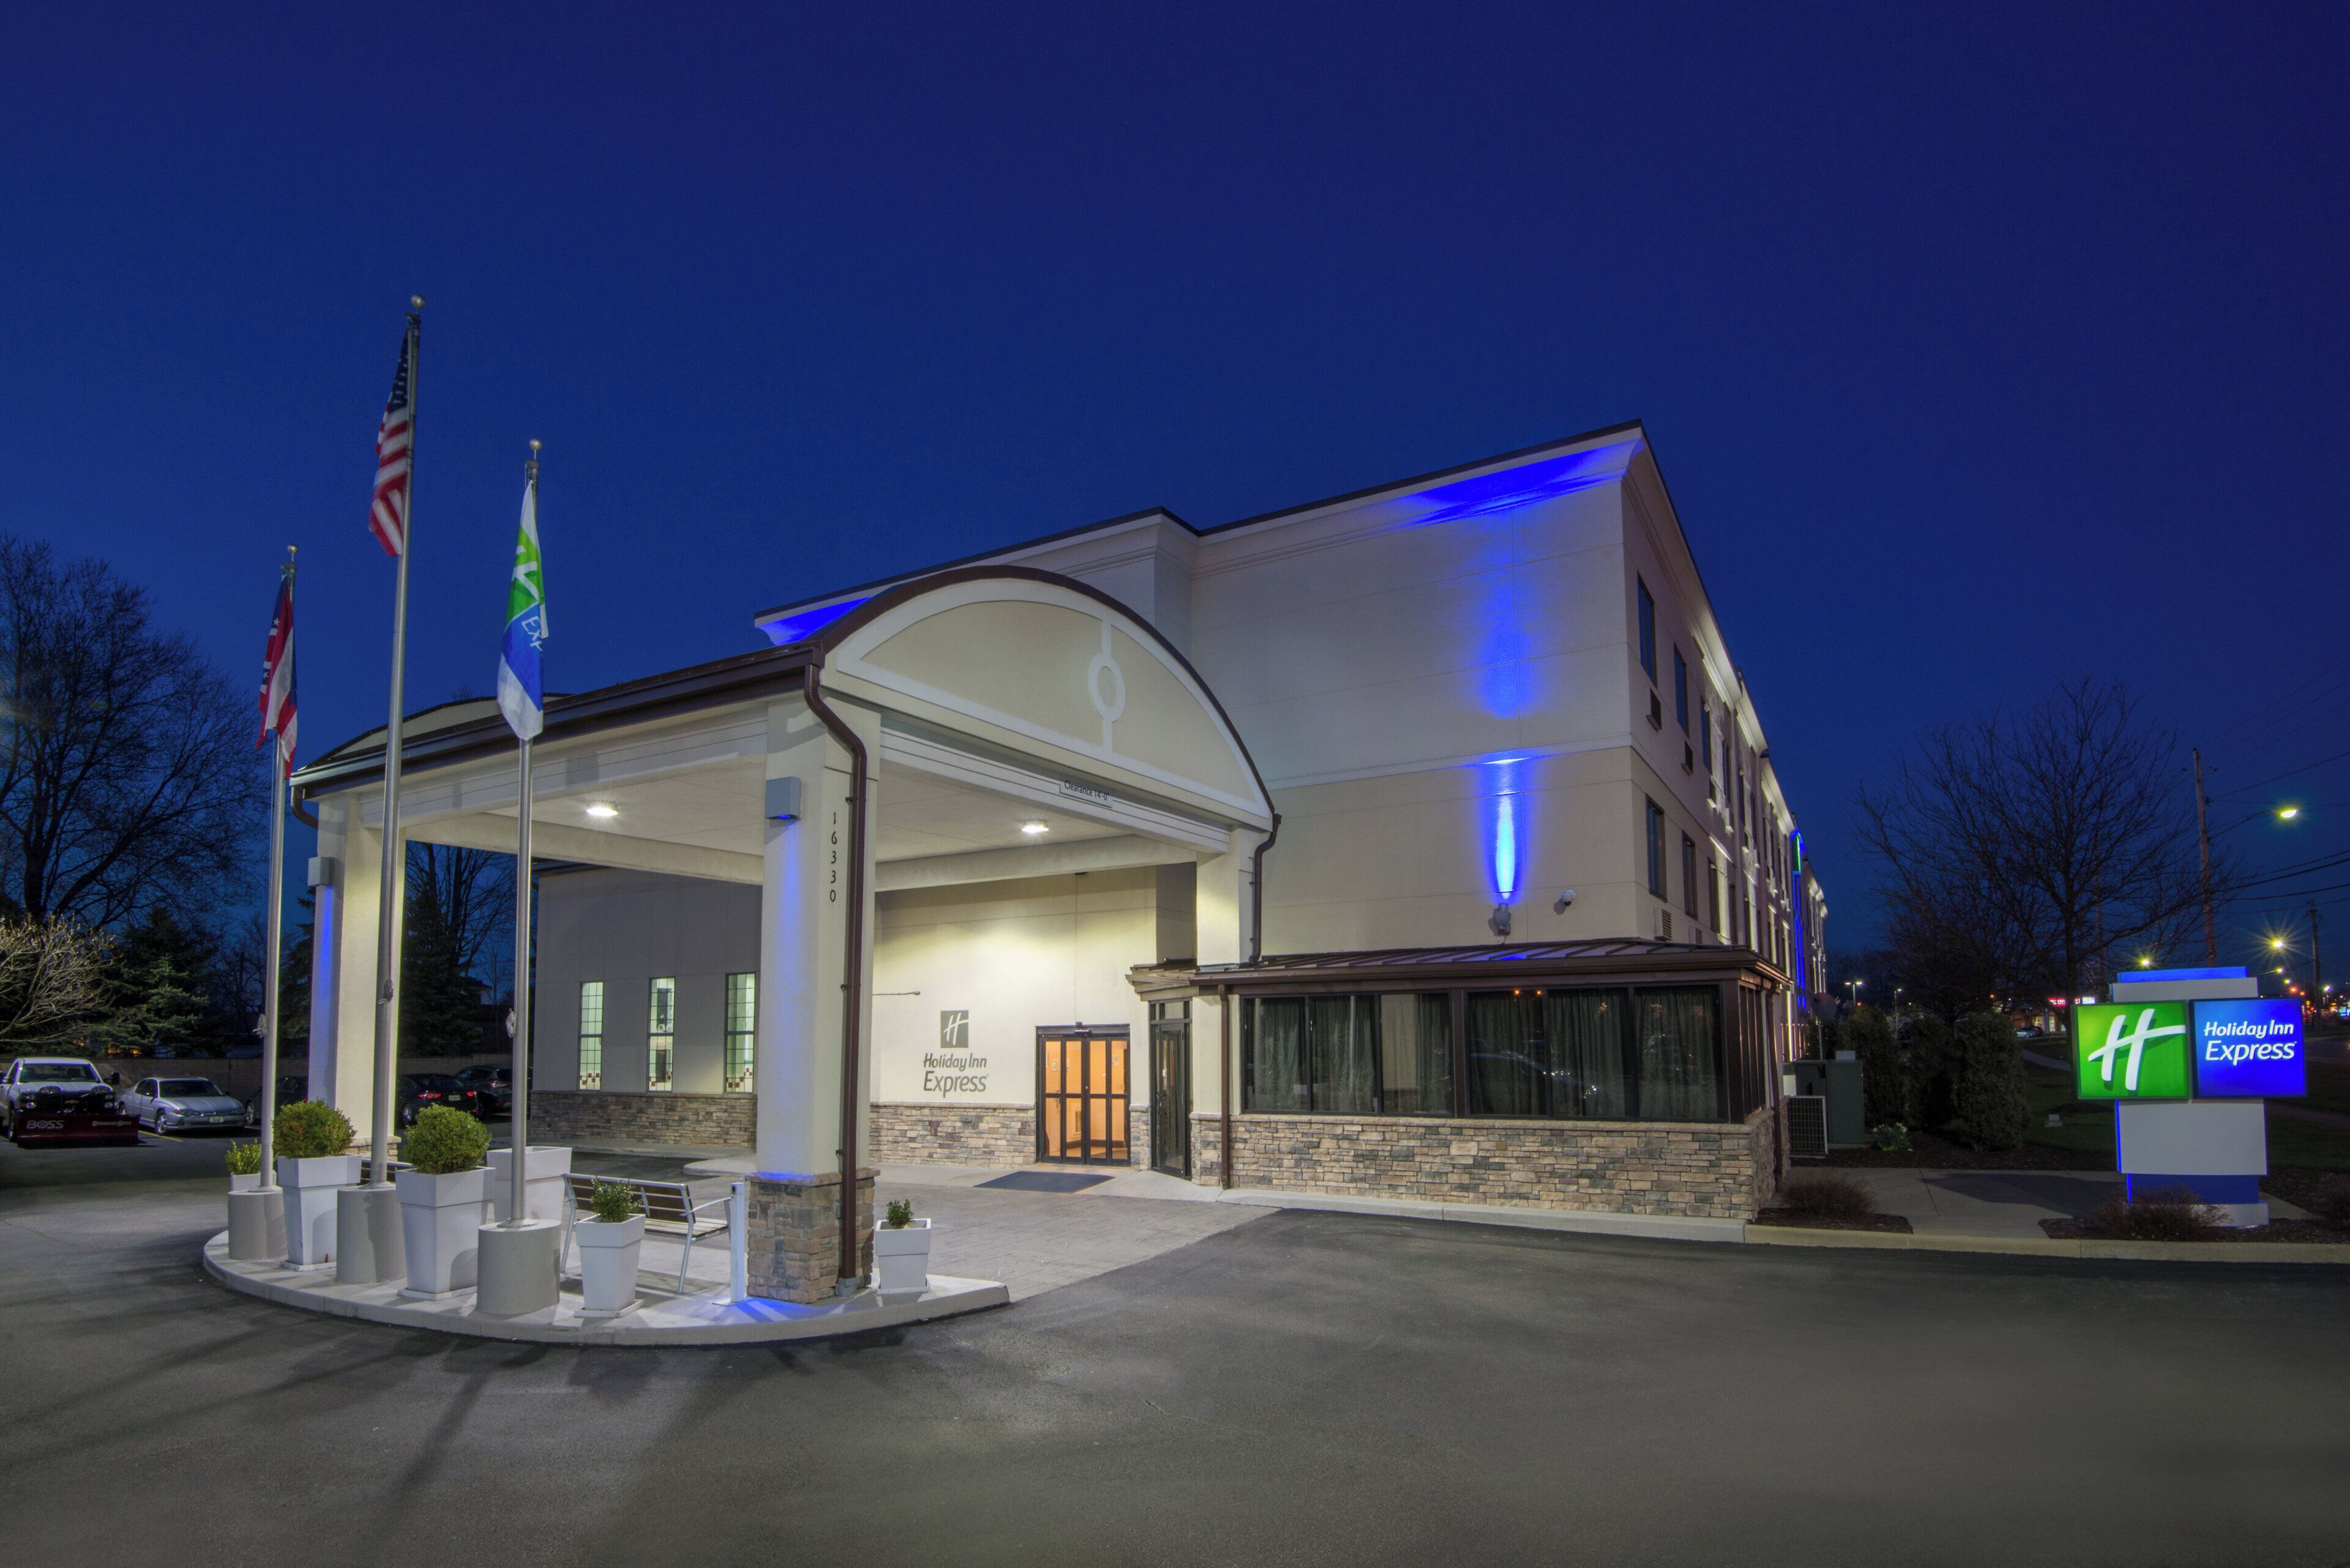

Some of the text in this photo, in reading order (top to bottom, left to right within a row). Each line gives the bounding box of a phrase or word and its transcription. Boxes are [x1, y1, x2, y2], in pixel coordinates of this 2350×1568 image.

[1064, 780, 1110, 801] Clearance 14'-0"
[2203, 1020, 2294, 1039] Holiday Inn
[923, 1053, 987, 1072] Holiday Inn
[2205, 1040, 2296, 1066] Express
[923, 1070, 987, 1099] Express
[26, 1120, 65, 1129] BOSS
